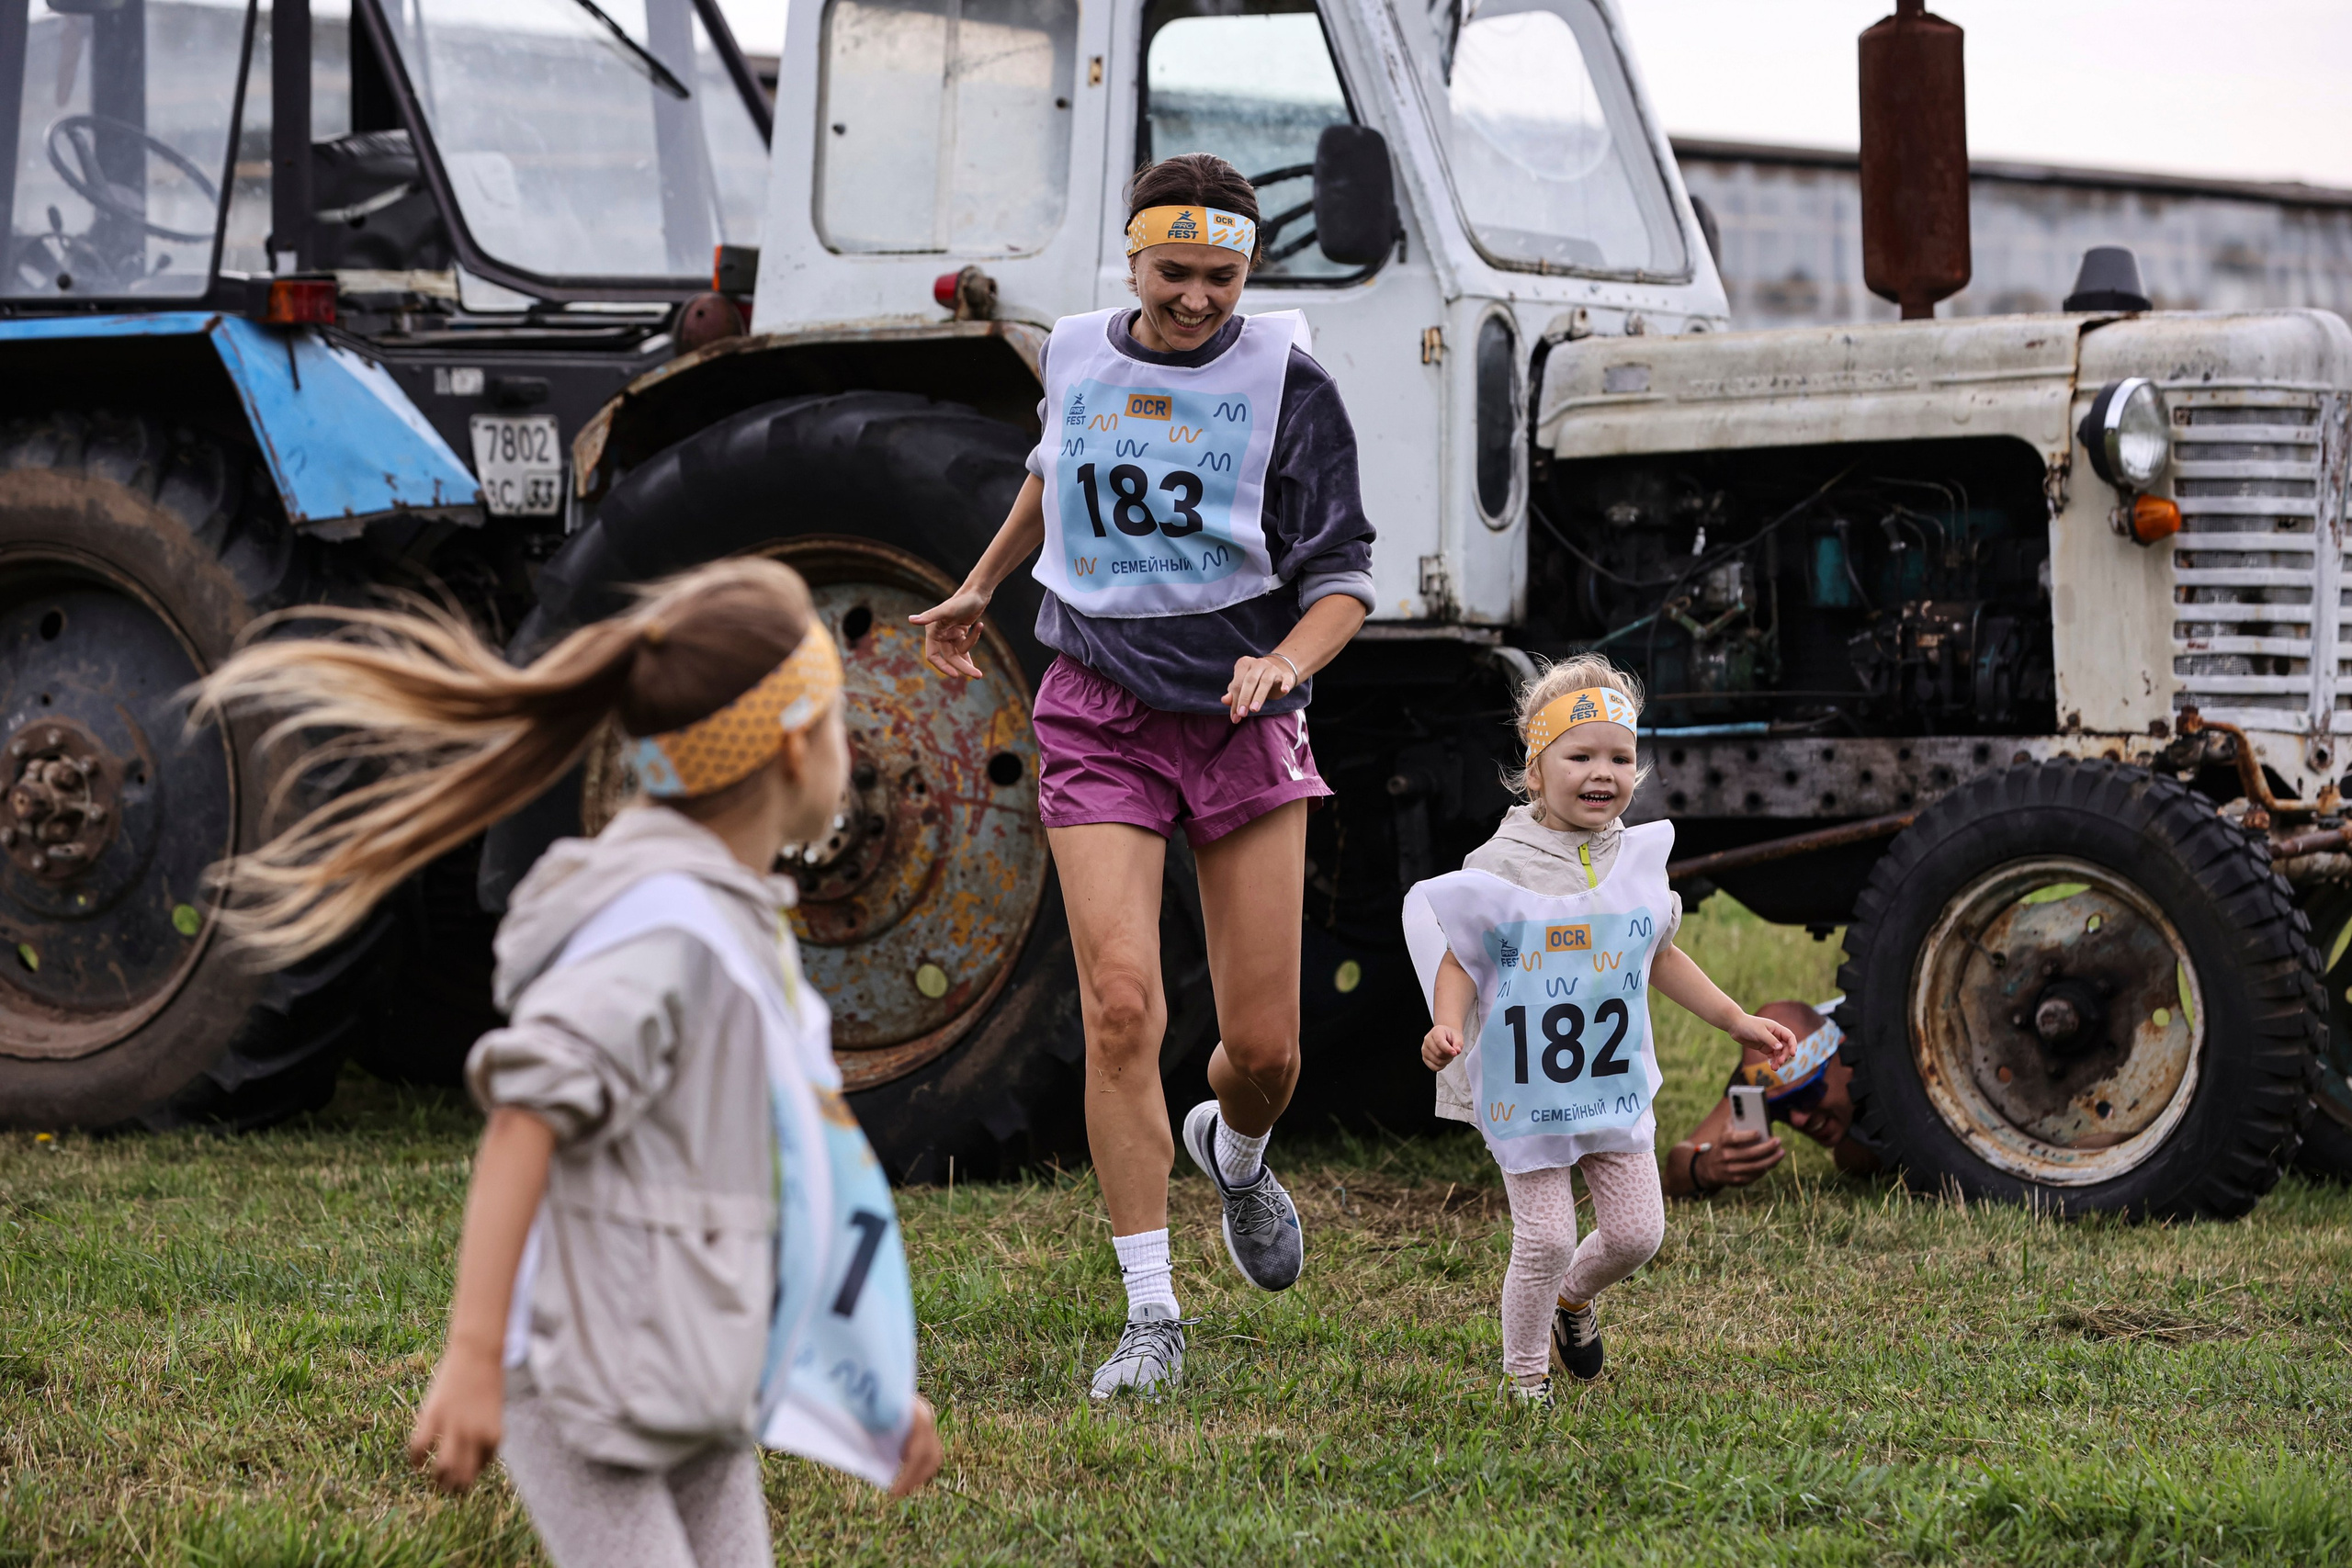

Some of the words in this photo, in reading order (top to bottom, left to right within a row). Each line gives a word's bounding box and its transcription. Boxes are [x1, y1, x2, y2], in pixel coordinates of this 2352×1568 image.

[1216, 216, 1234, 226] OCR
[1168, 230, 1199, 239] FEST
[1131, 399, 1167, 416] OCR
[1066, 415, 1087, 426] FEST
[483, 424, 550, 463] 7802
[527, 479, 554, 509] 33
[1077, 462, 1204, 538] 183
[1111, 556, 1193, 575] СЕМЕЙНЫЙ
[1569, 709, 1599, 723] FEST
[1574, 703, 1594, 712] PRO
[1550, 929, 1587, 947] OCR
[1504, 998, 1630, 1085] 182
[1531, 1098, 1608, 1123] СЕМЕЙНЫЙ
